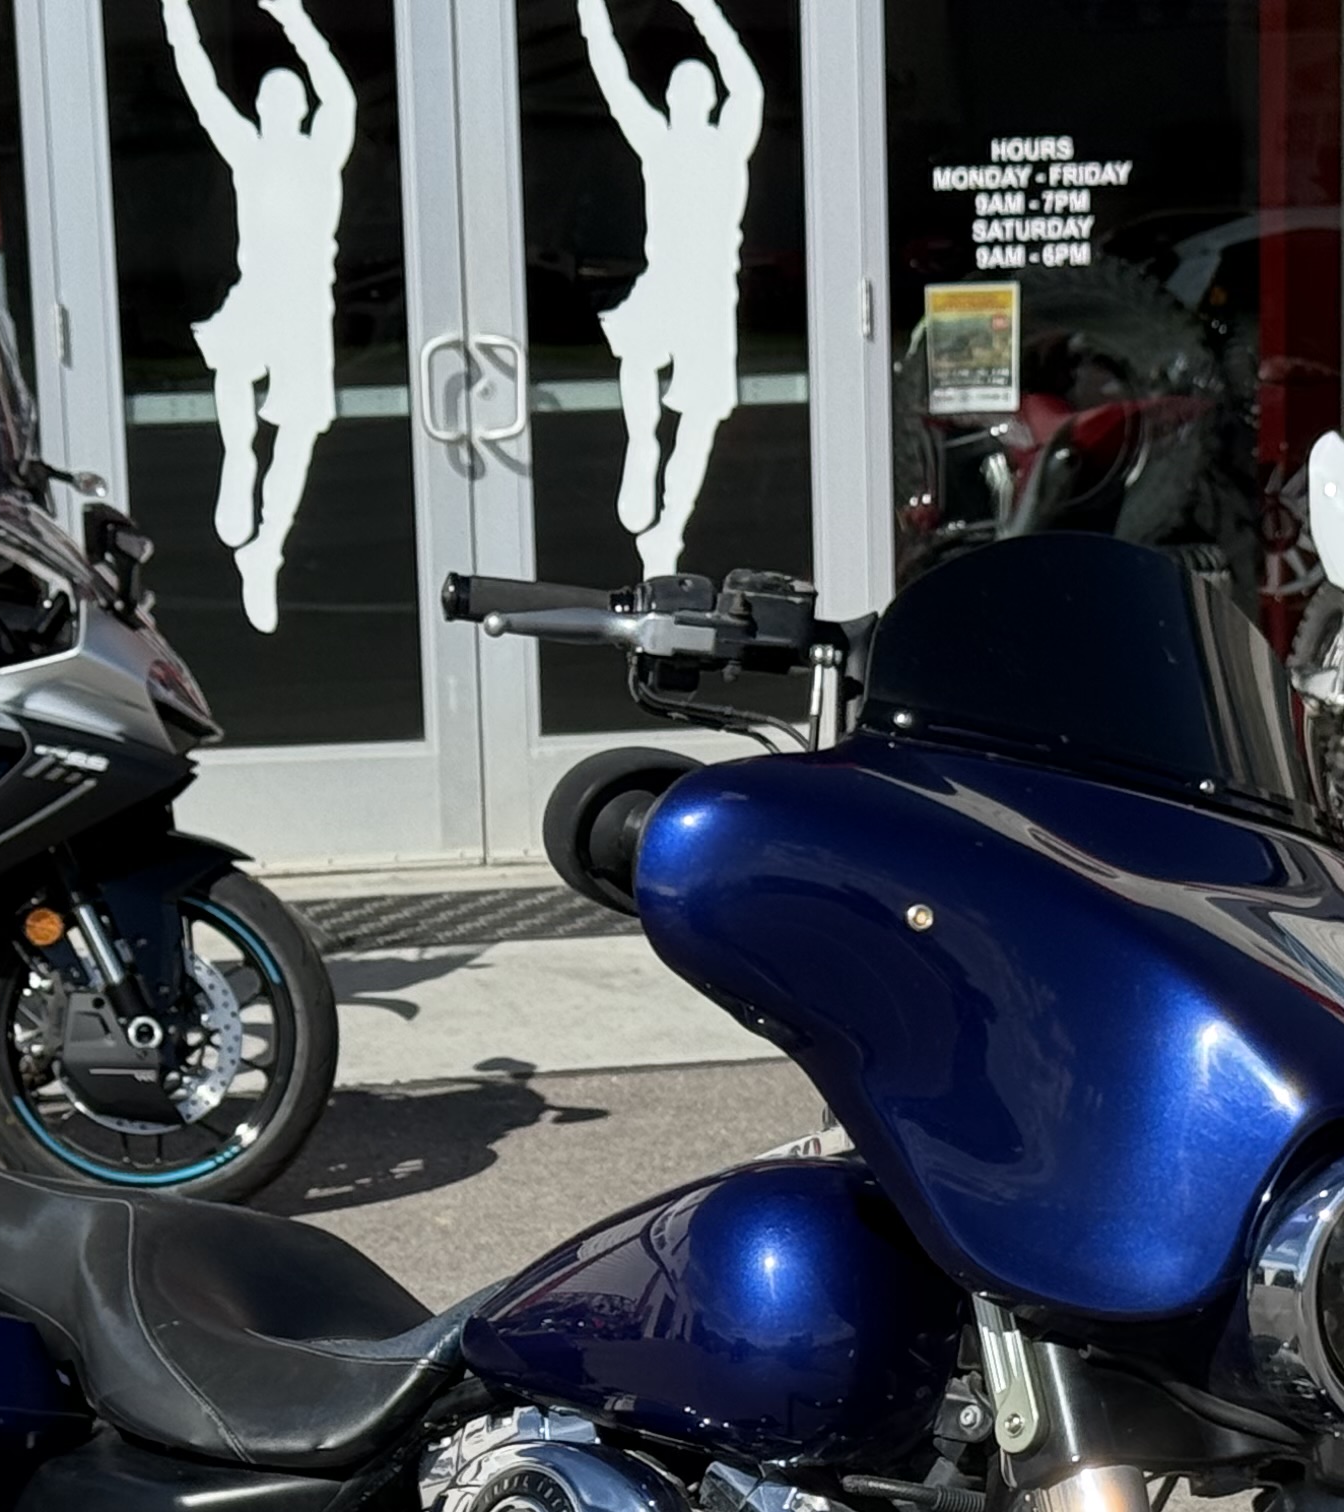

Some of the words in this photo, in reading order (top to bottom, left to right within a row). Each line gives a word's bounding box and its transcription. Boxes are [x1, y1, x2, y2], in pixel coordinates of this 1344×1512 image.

[991, 136, 1074, 162] HOURS
[933, 164, 1033, 191] MONDAY
[1049, 160, 1133, 187] FRIDAY
[975, 191, 1026, 216] 9AM
[1041, 188, 1091, 214] 7PM
[972, 215, 1095, 243] SATURDAY
[976, 244, 1026, 270] 9AM
[1042, 242, 1092, 267] 6PM
